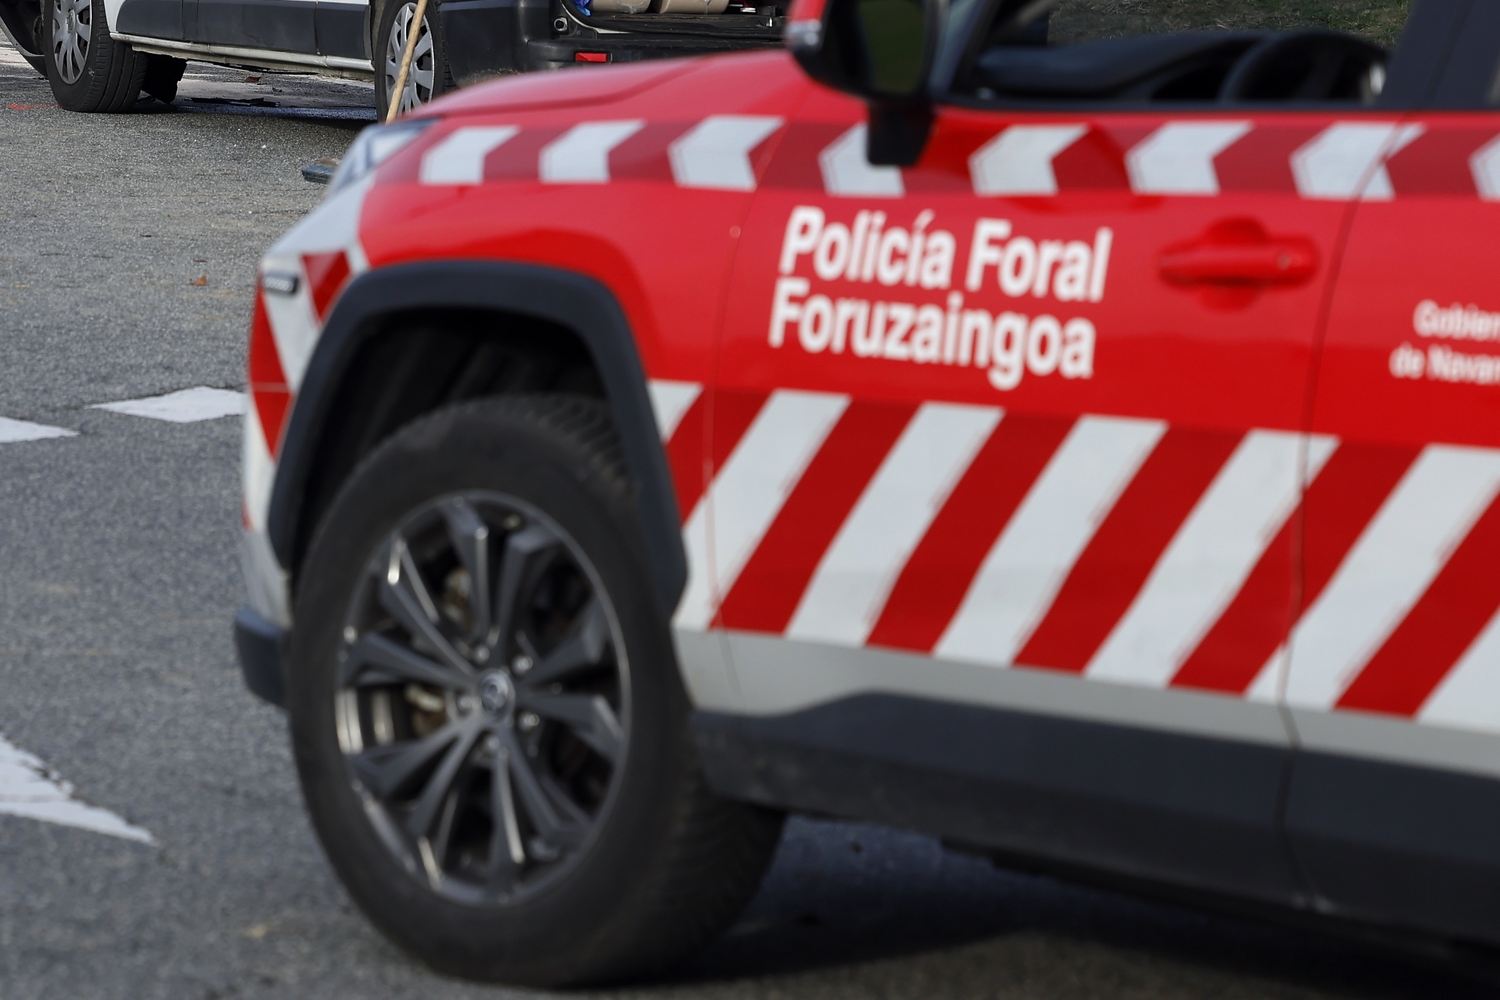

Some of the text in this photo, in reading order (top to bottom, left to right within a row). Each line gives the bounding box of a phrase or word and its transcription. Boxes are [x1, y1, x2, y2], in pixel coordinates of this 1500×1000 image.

[778, 205, 1114, 303] Policía Foral
[767, 275, 1097, 392] Foruzaingoa
[1388, 340, 1426, 380] de
